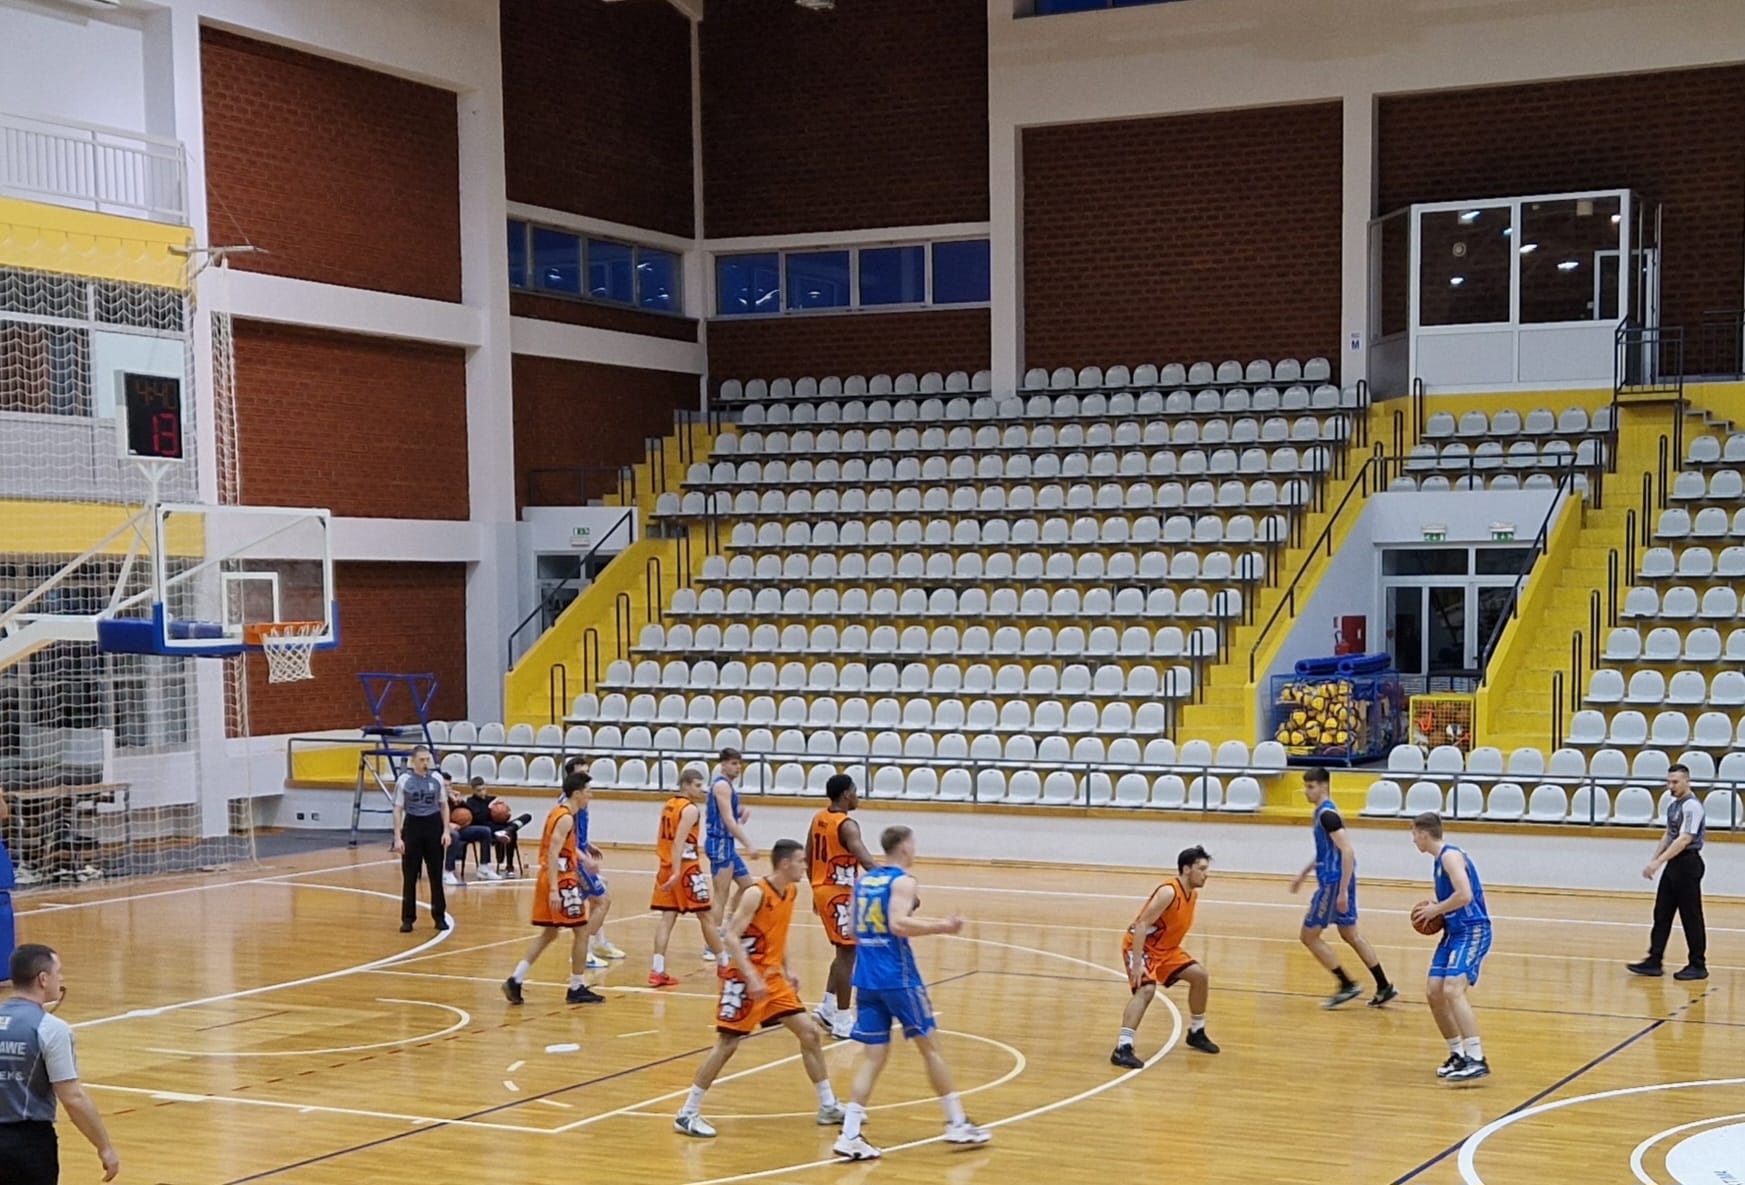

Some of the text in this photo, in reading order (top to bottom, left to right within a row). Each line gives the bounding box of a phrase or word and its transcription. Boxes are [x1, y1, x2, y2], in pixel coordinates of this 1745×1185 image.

[152, 412, 178, 456] 13
[814, 833, 828, 863] 18
[857, 896, 888, 932] 14
